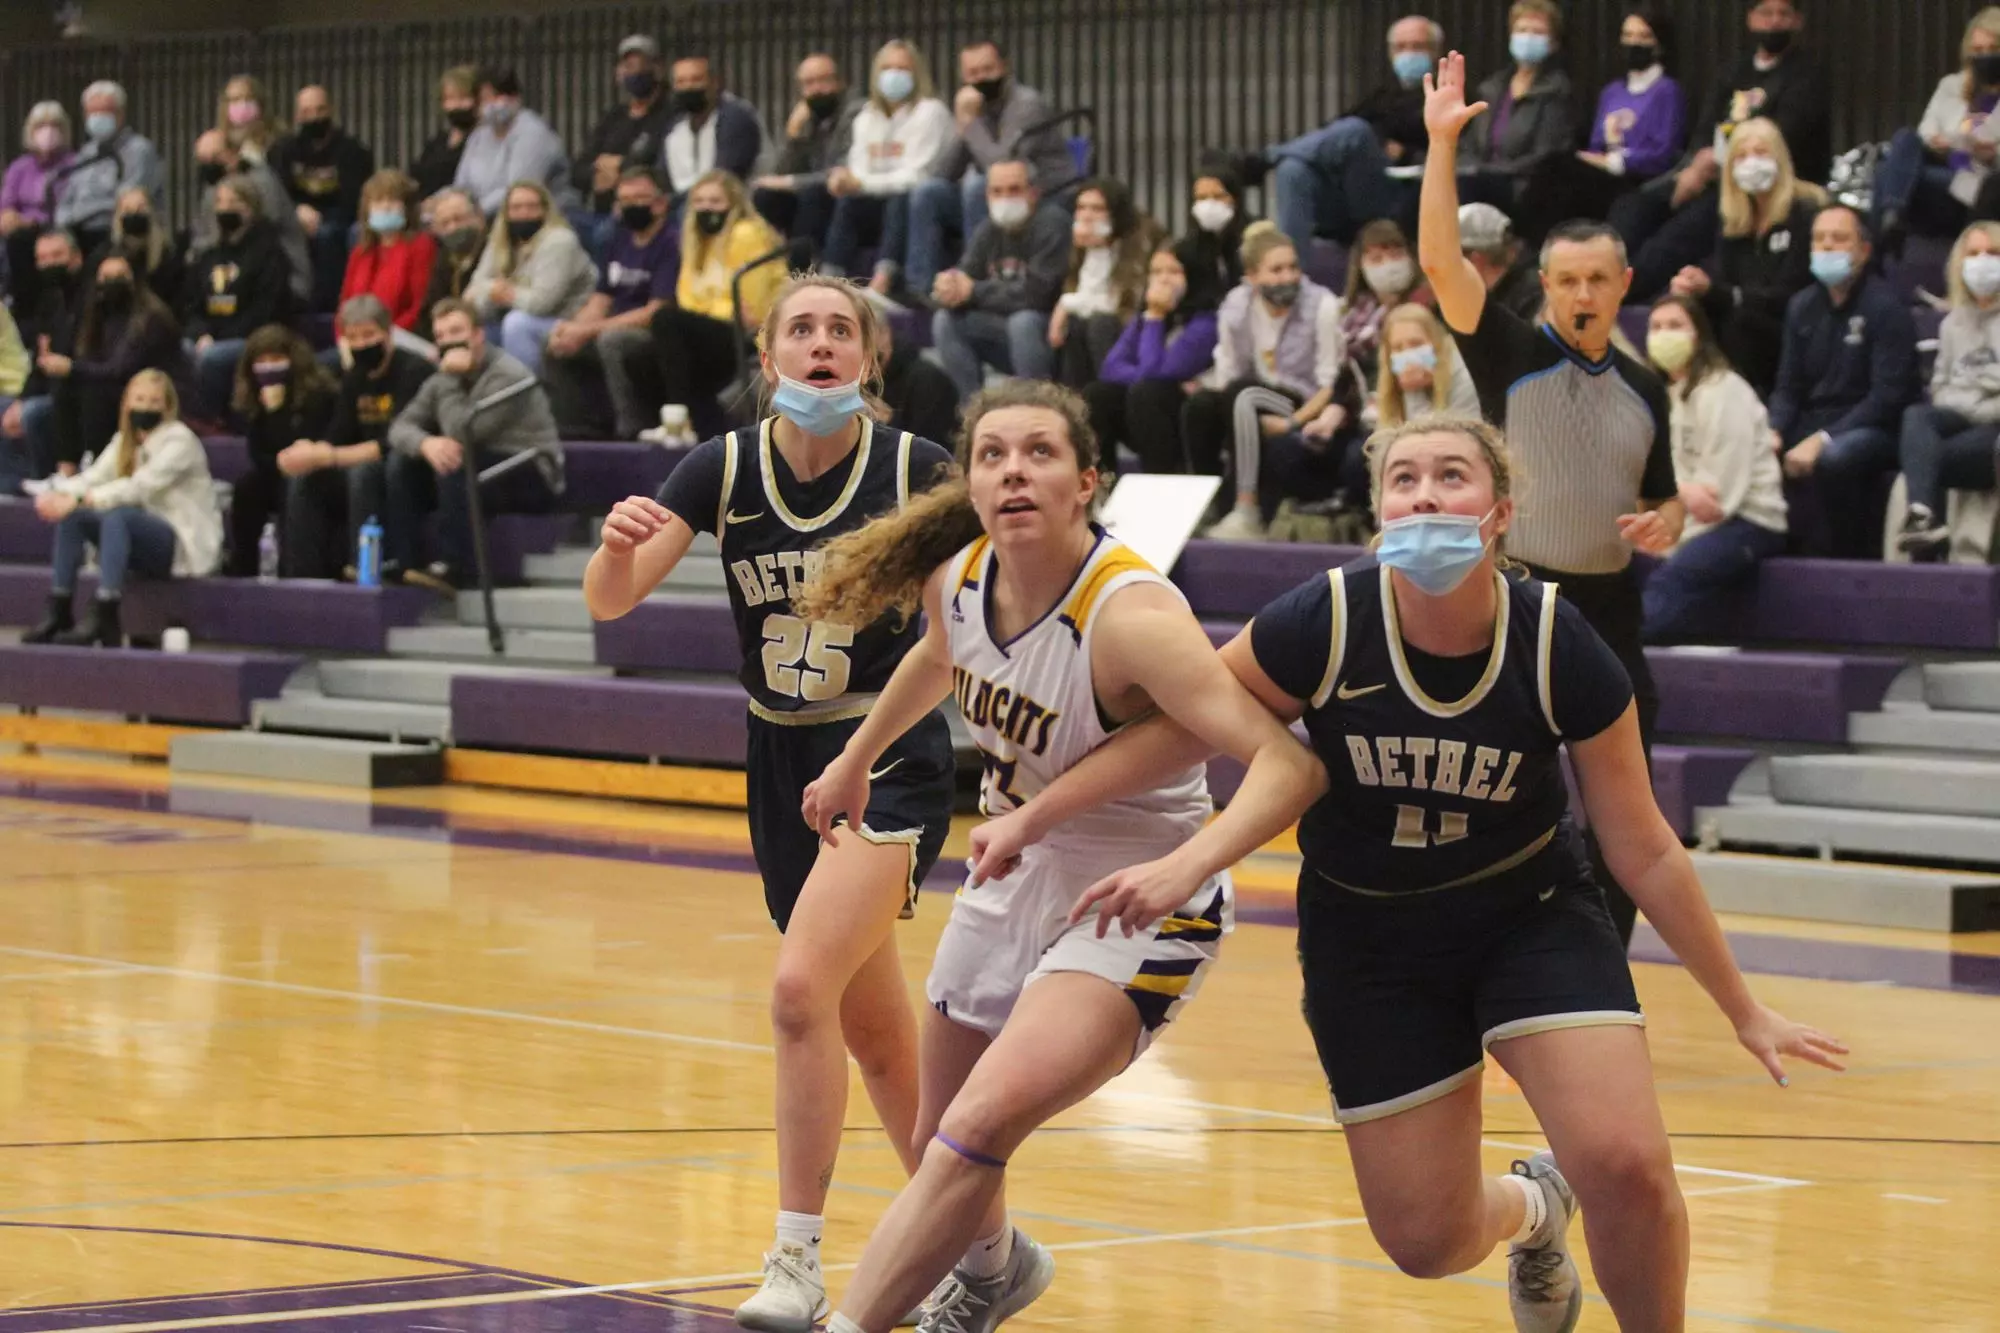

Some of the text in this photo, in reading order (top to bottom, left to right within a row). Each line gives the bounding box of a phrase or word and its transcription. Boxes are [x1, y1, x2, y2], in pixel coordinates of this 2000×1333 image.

[731, 551, 826, 607] BETH
[761, 613, 854, 702] 25
[1345, 735, 1523, 802] BETHEL
